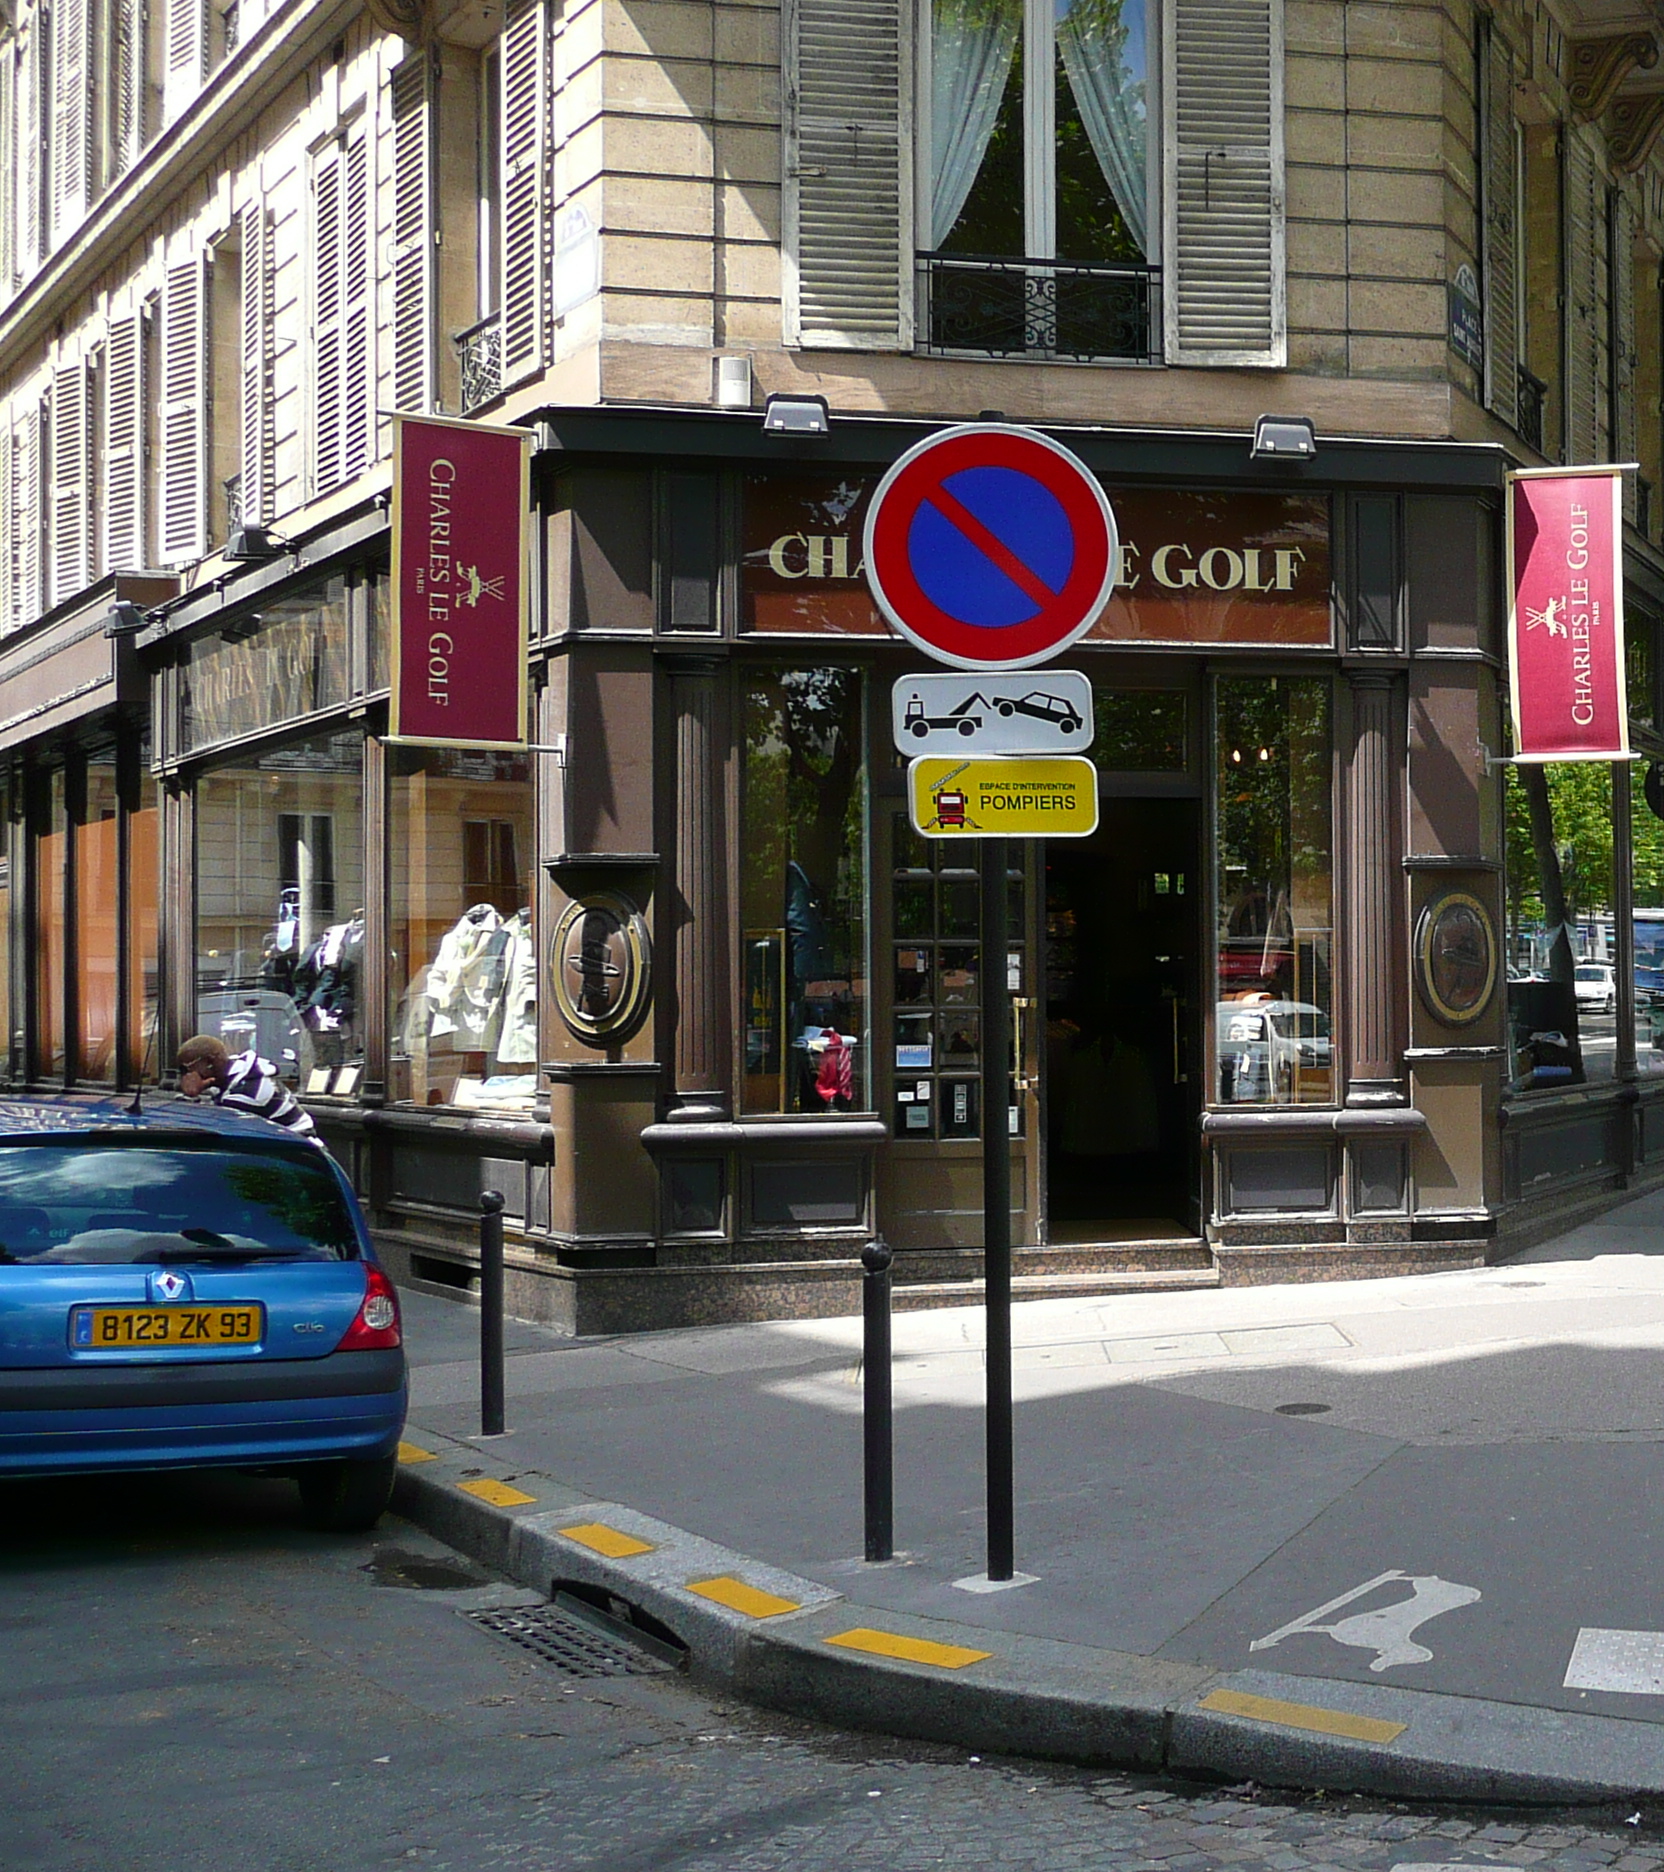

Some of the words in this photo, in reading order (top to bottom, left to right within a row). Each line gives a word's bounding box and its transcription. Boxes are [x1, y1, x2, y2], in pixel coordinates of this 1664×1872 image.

[429, 458, 456, 583] CHARLES
[1566, 503, 1589, 570] GOLF
[415, 567, 425, 594] PARIS
[1113, 540, 1141, 590] E
[1150, 542, 1306, 593] GOLF
[428, 592, 449, 621] LE
[1571, 578, 1589, 606] LE
[428, 632, 454, 706] GOLF
[1571, 613, 1594, 725] CHARLES
[979, 783, 1011, 791] ESPACE
[980, 795, 1076, 810] POMPIERS
[101, 1314, 170, 1341] 8123
[179, 1313, 211, 1339] ZK
[219, 1312, 251, 1338] 93
